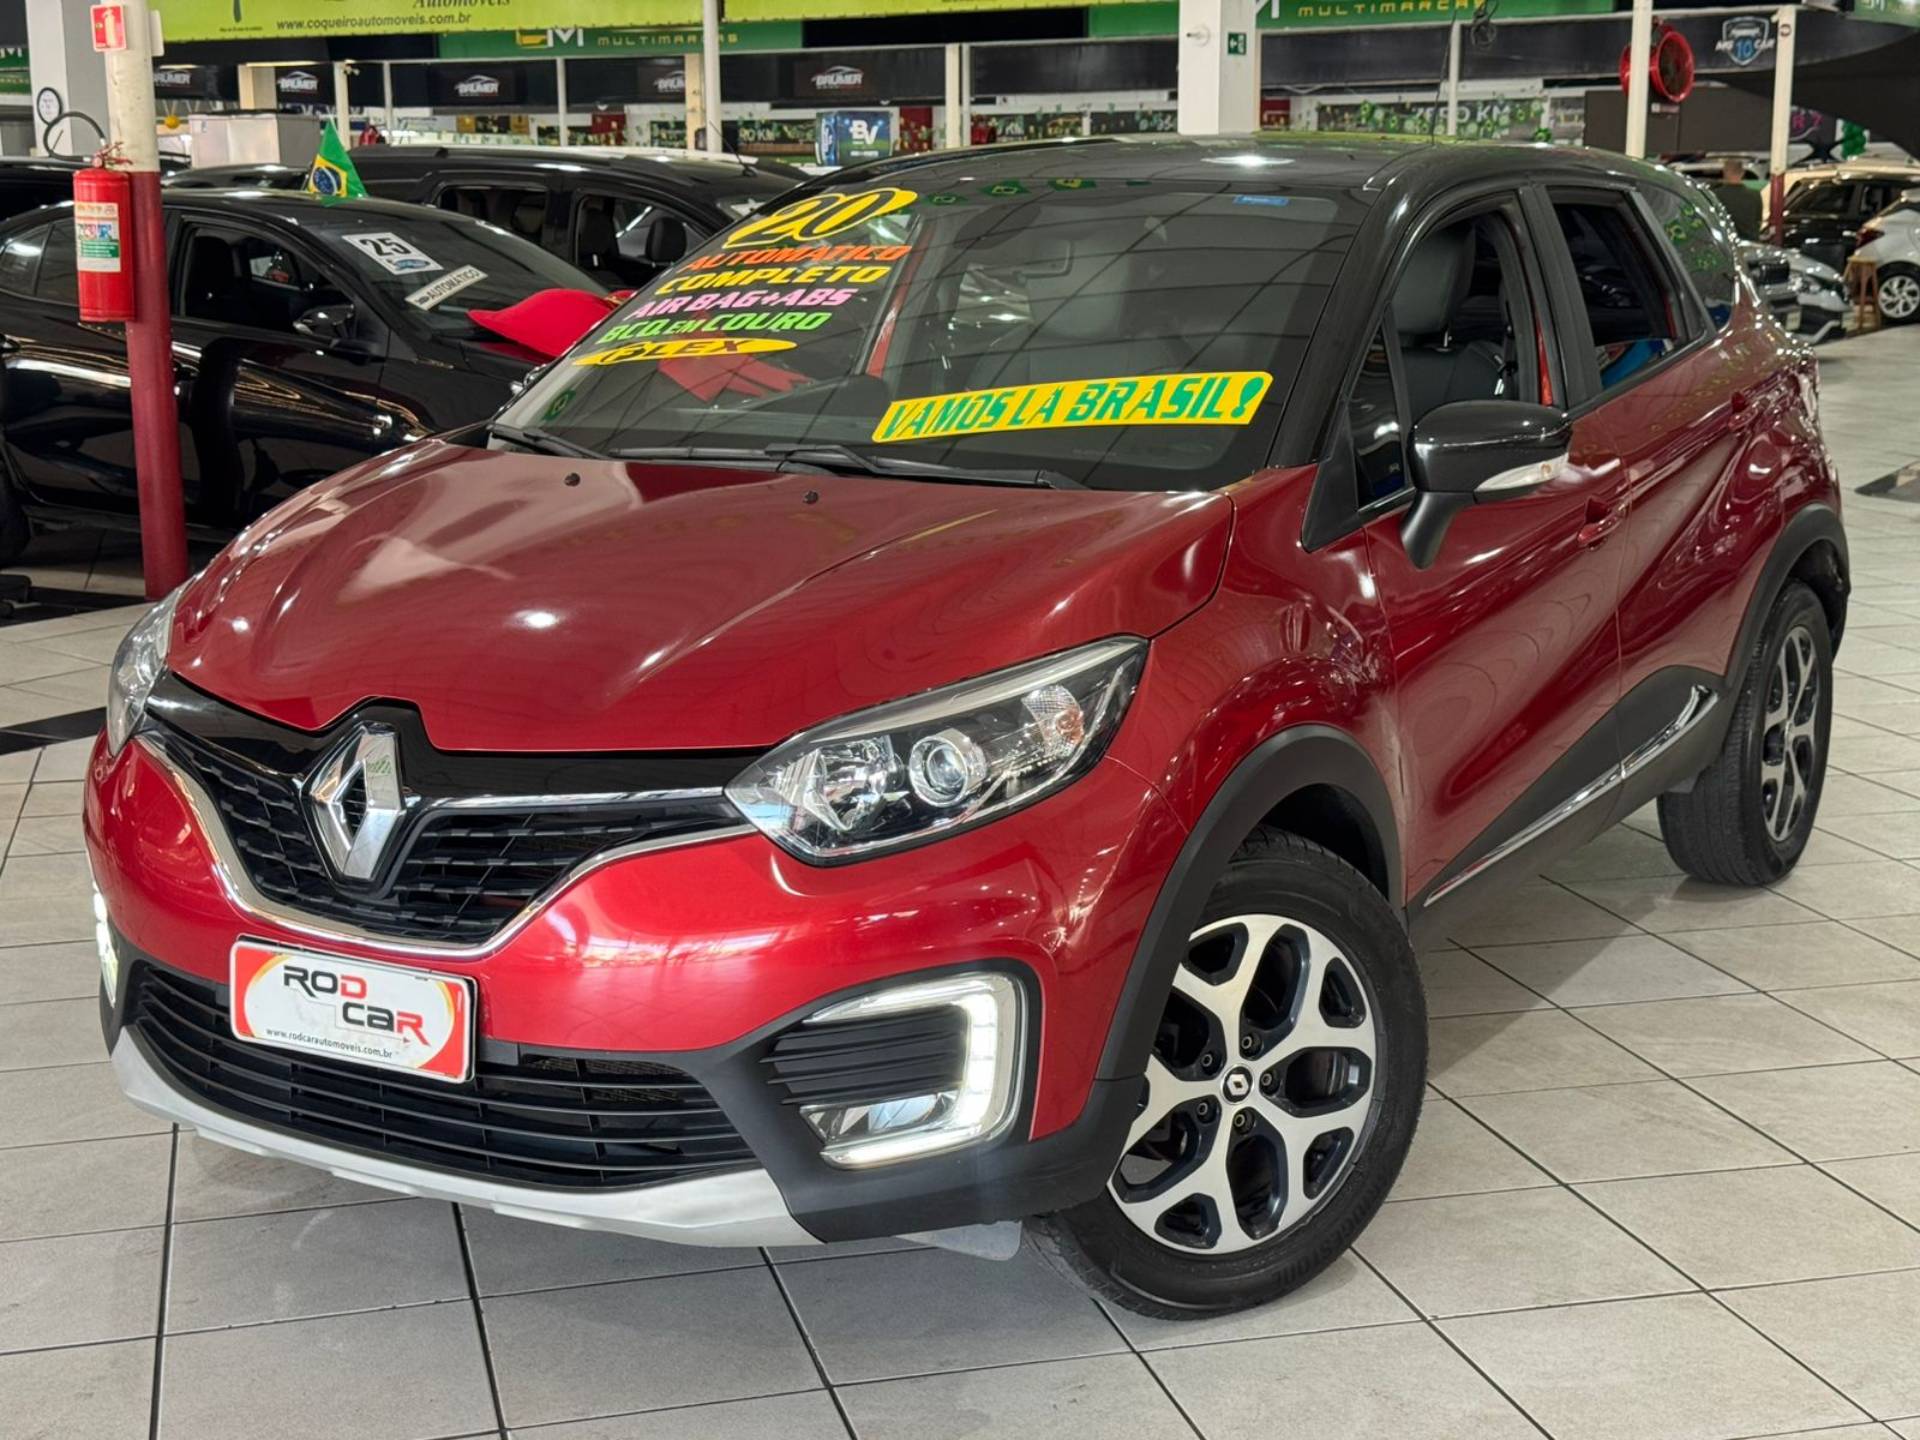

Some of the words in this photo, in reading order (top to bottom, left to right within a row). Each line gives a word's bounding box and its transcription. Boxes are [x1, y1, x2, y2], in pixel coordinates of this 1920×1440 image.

[276, 13, 471, 31] www.coqueiroautomoveis.com.br
[597, 33, 739, 46] MULTIMARAS
[724, 188, 918, 249] 20
[359, 237, 412, 257] 25
[655, 266, 891, 295] COMPLETO
[623, 299, 692, 321] AIR
[683, 288, 858, 313] BAG+ABS
[700, 312, 832, 333] COURO
[881, 391, 1017, 439] VAMOS
[284, 965, 367, 999] ROD
[266, 1026, 393, 1058] www.rodcarautomoveis.com.br
